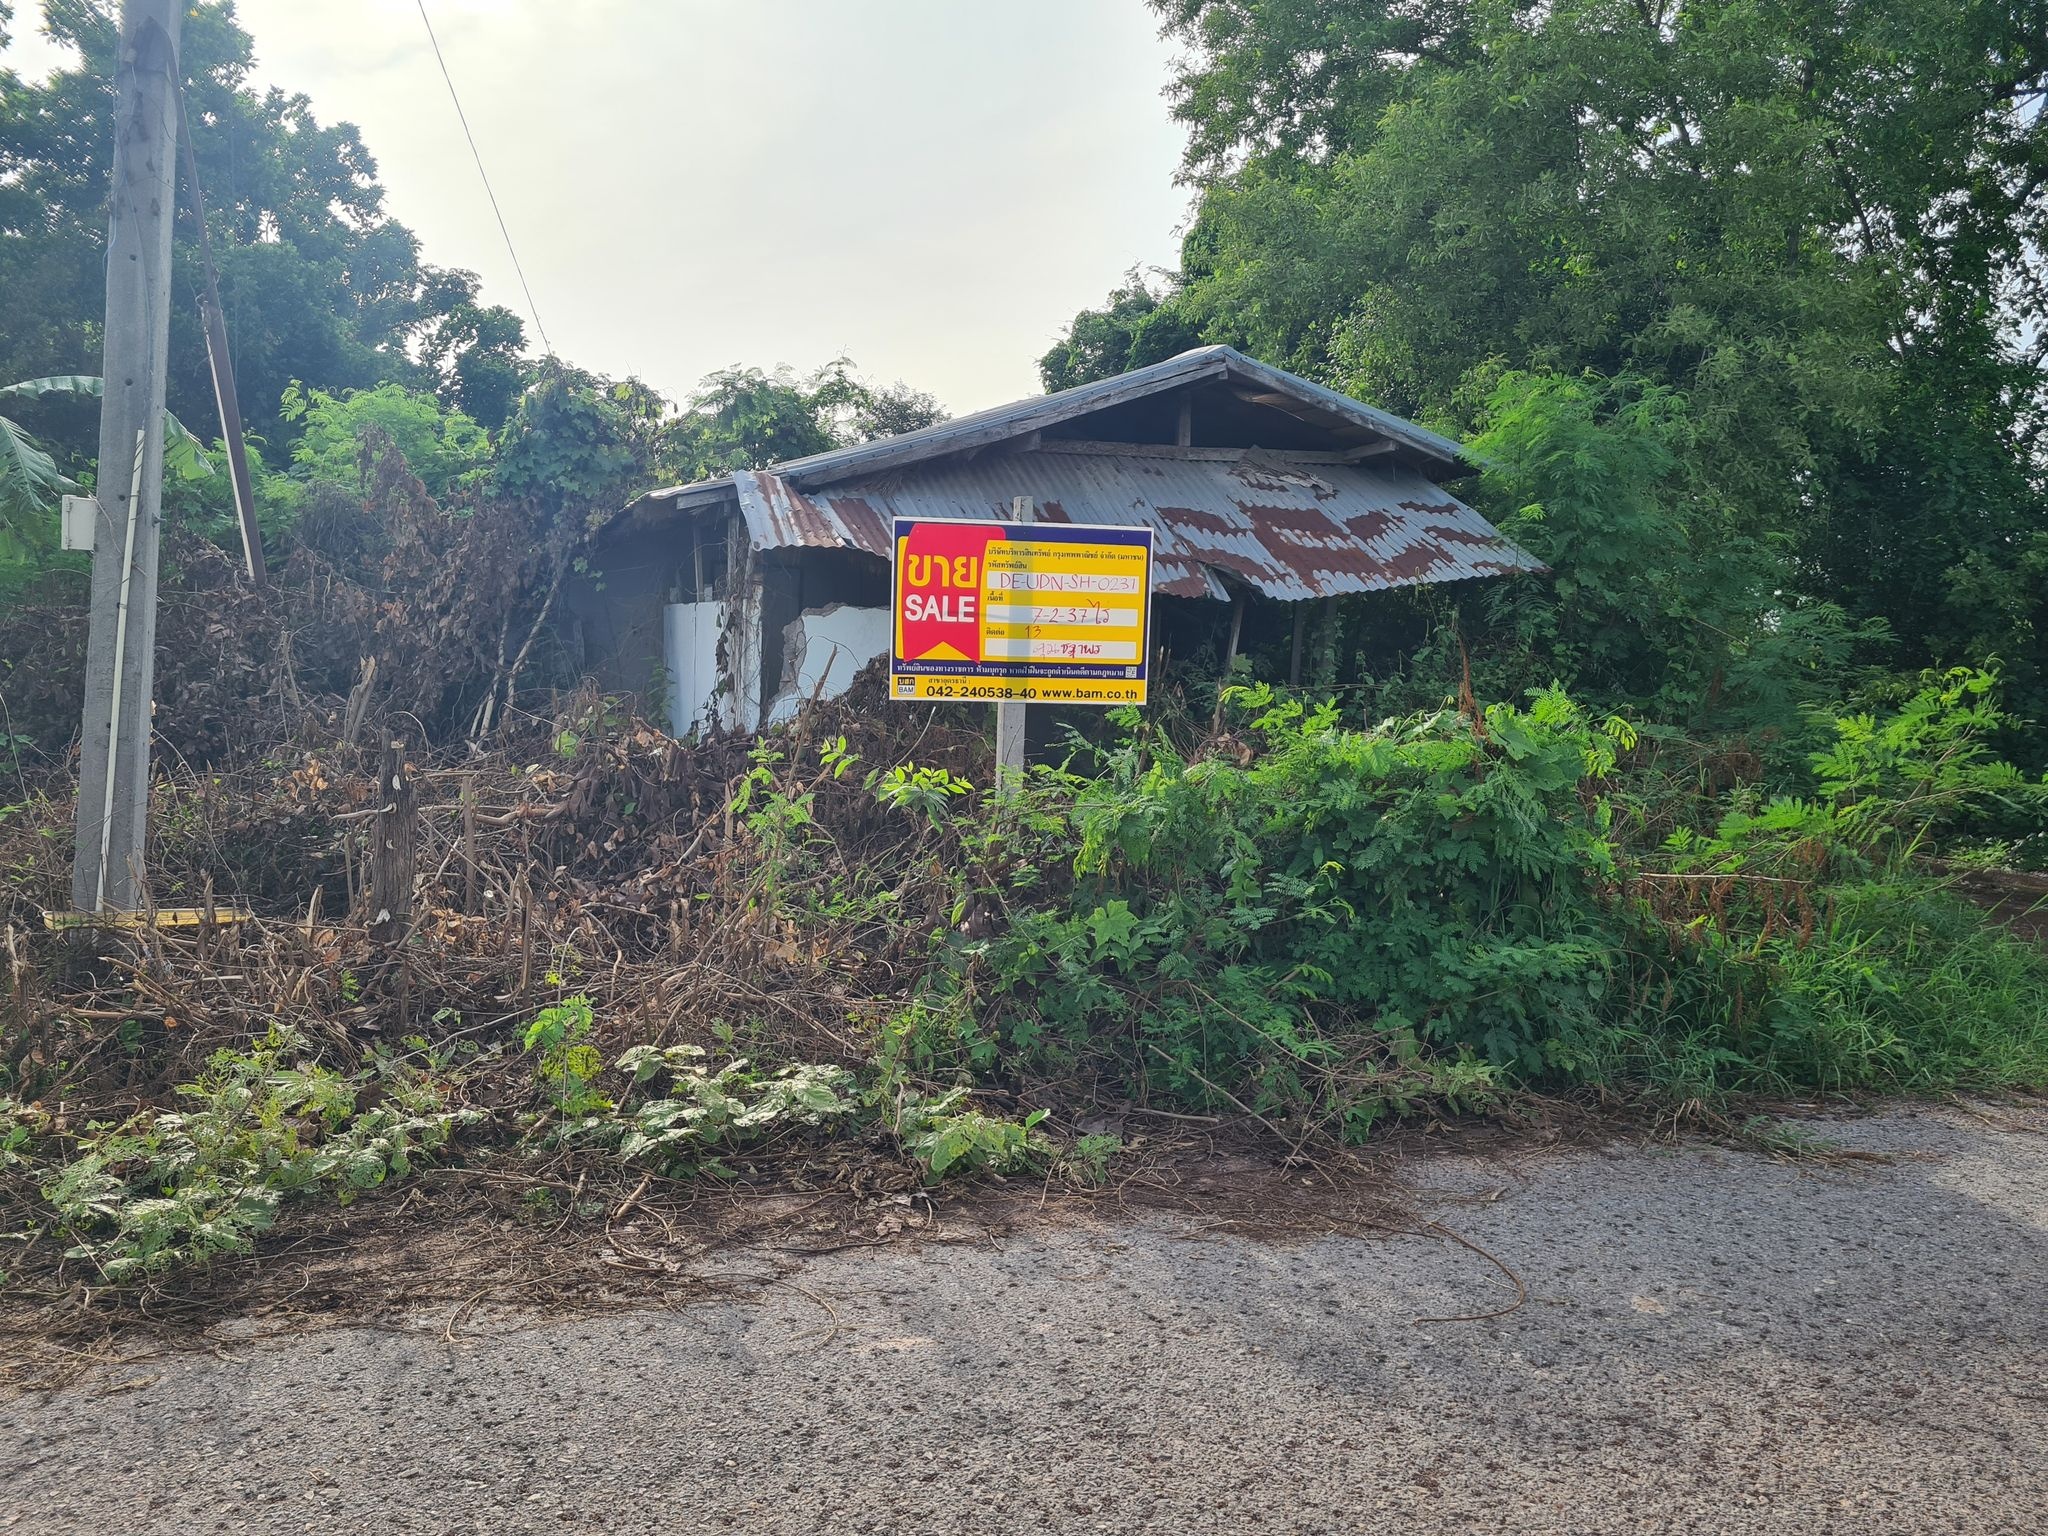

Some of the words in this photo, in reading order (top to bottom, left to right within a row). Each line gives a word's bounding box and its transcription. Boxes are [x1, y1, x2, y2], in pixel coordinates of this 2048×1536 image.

[1100, 552, 1116, 561] จำกัด
[1117, 553, 1144, 562] (มหาชน)
[988, 559, 1028, 569] รหัสทรัพย์สิน
[908, 554, 978, 588] ขาย
[986, 590, 1004, 602] เนื้อที่
[904, 594, 975, 623] SALE
[986, 627, 1005, 636] ติดต่อ
[897, 662, 974, 674] ทรัพย์สินของทางราชการ
[976, 664, 1007, 677] ห้ามบุกรุก
[926, 686, 1037, 699] 042-240538-40
[1042, 688, 1137, 699] www.bam.co.th
